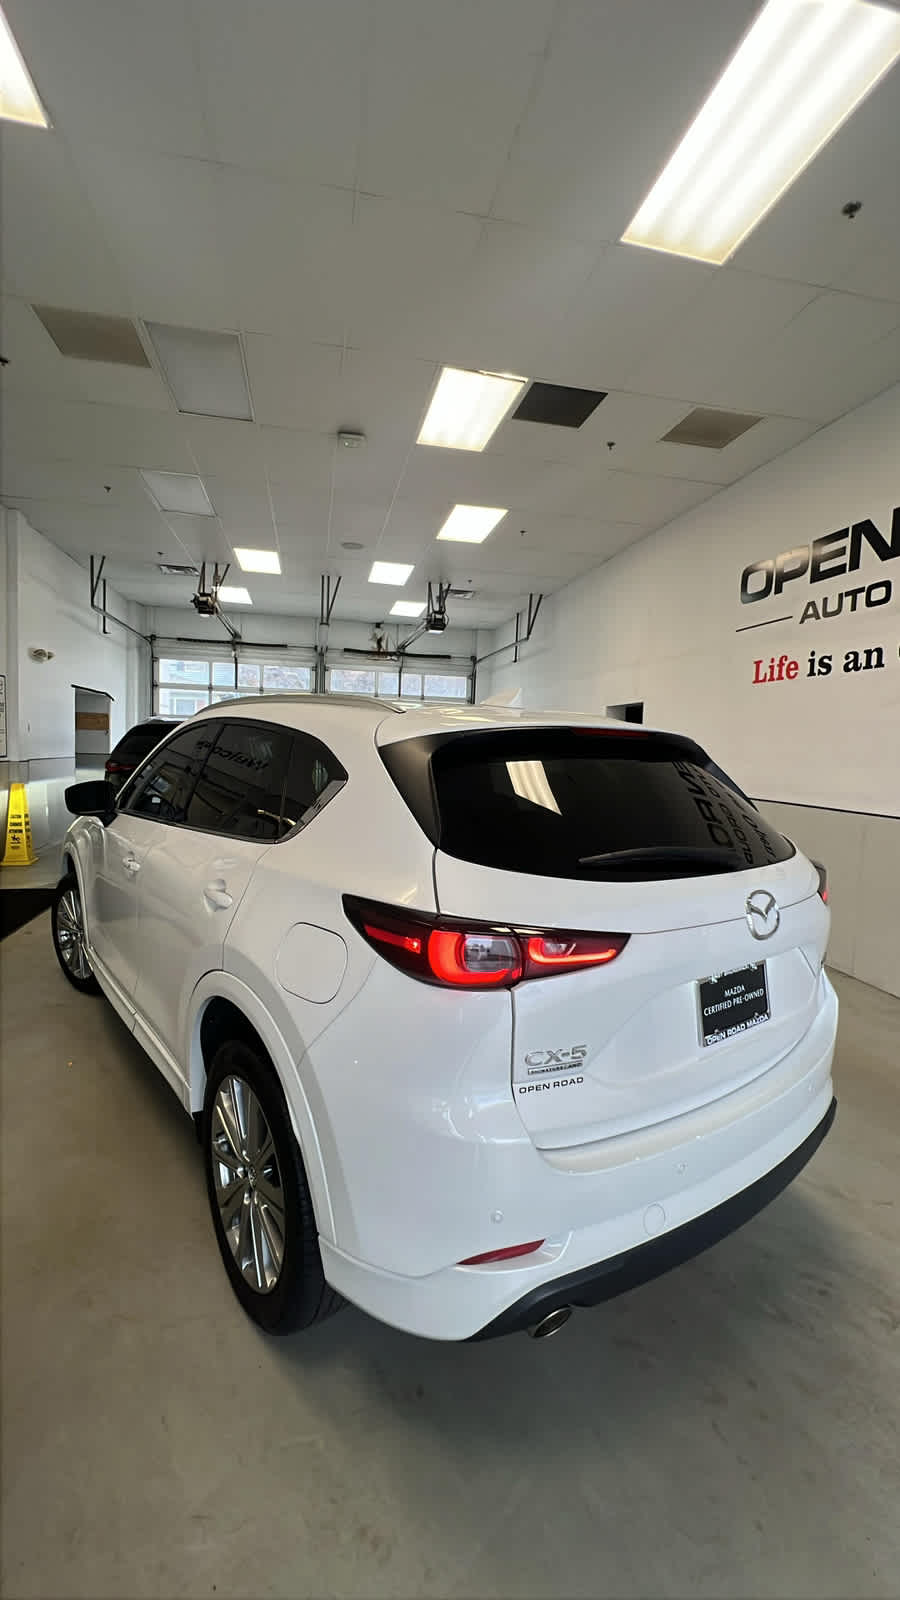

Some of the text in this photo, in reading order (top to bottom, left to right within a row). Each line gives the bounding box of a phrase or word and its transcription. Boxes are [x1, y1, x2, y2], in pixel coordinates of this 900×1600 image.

[740, 506, 900, 604] OPEN
[799, 580, 892, 624] AUTO
[752, 655, 799, 684] Life
[807, 651, 833, 677] is
[843, 646, 885, 673] an
[703, 988, 765, 1017] CERTIFIED PRE-OWNED
[724, 984, 746, 998] MAZDA
[727, 1023, 746, 1037] ROAD
[524, 1044, 587, 1066] CX-5
[518, 1076, 584, 1094] OPEN ROAD
